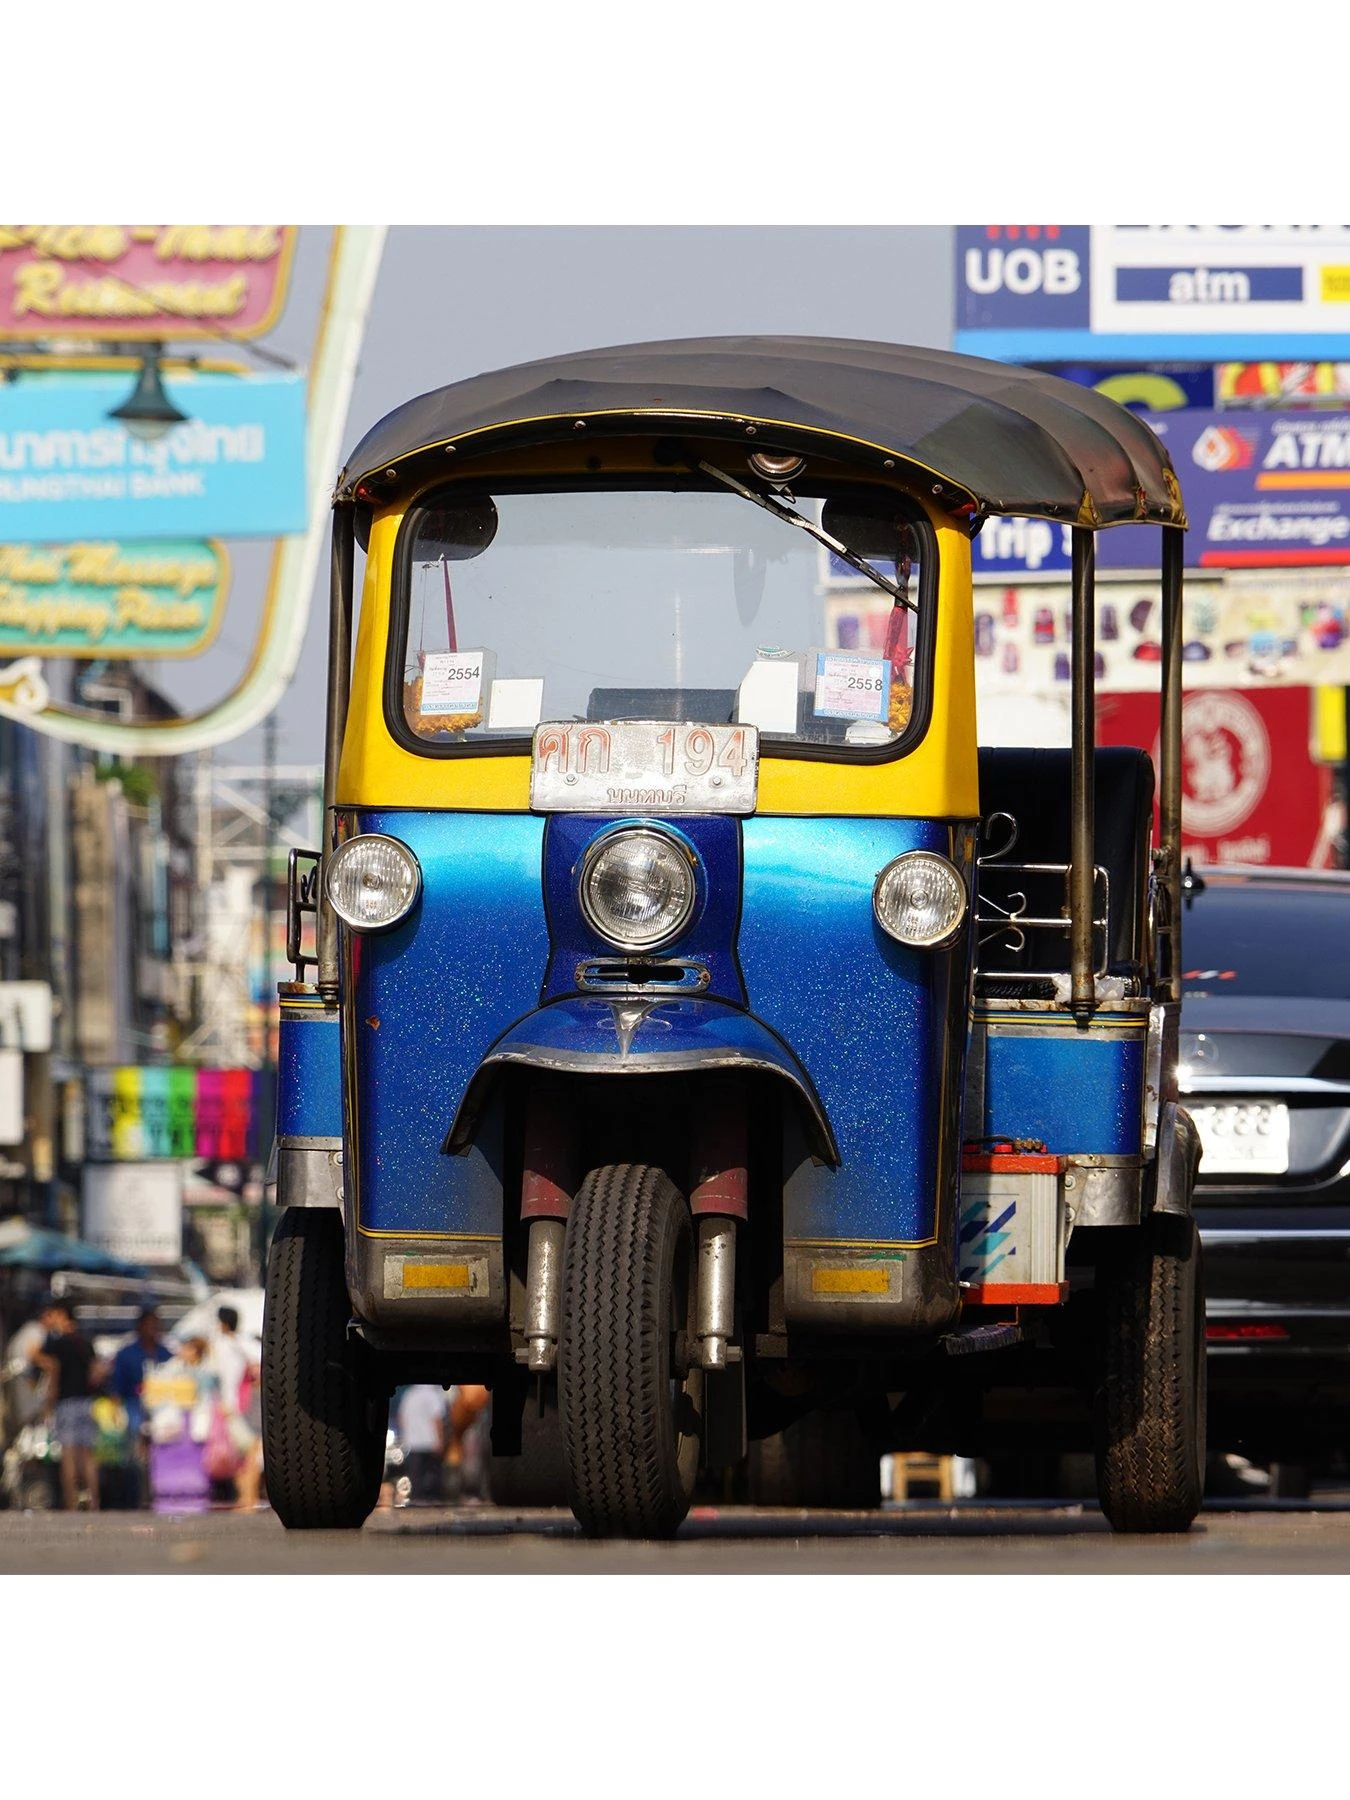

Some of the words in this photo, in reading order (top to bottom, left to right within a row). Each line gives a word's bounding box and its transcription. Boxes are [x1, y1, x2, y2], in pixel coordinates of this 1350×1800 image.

[966, 249, 1081, 294] UOB
[1168, 268, 1250, 302] atm
[1262, 433, 1350, 468] ATM
[131, 470, 206, 499] BANK
[1207, 513, 1350, 545] Exchange
[448, 666, 480, 681] 2554
[848, 677, 883, 691] 2558
[538, 725, 612, 774] ศก
[656, 728, 748, 777] 194
